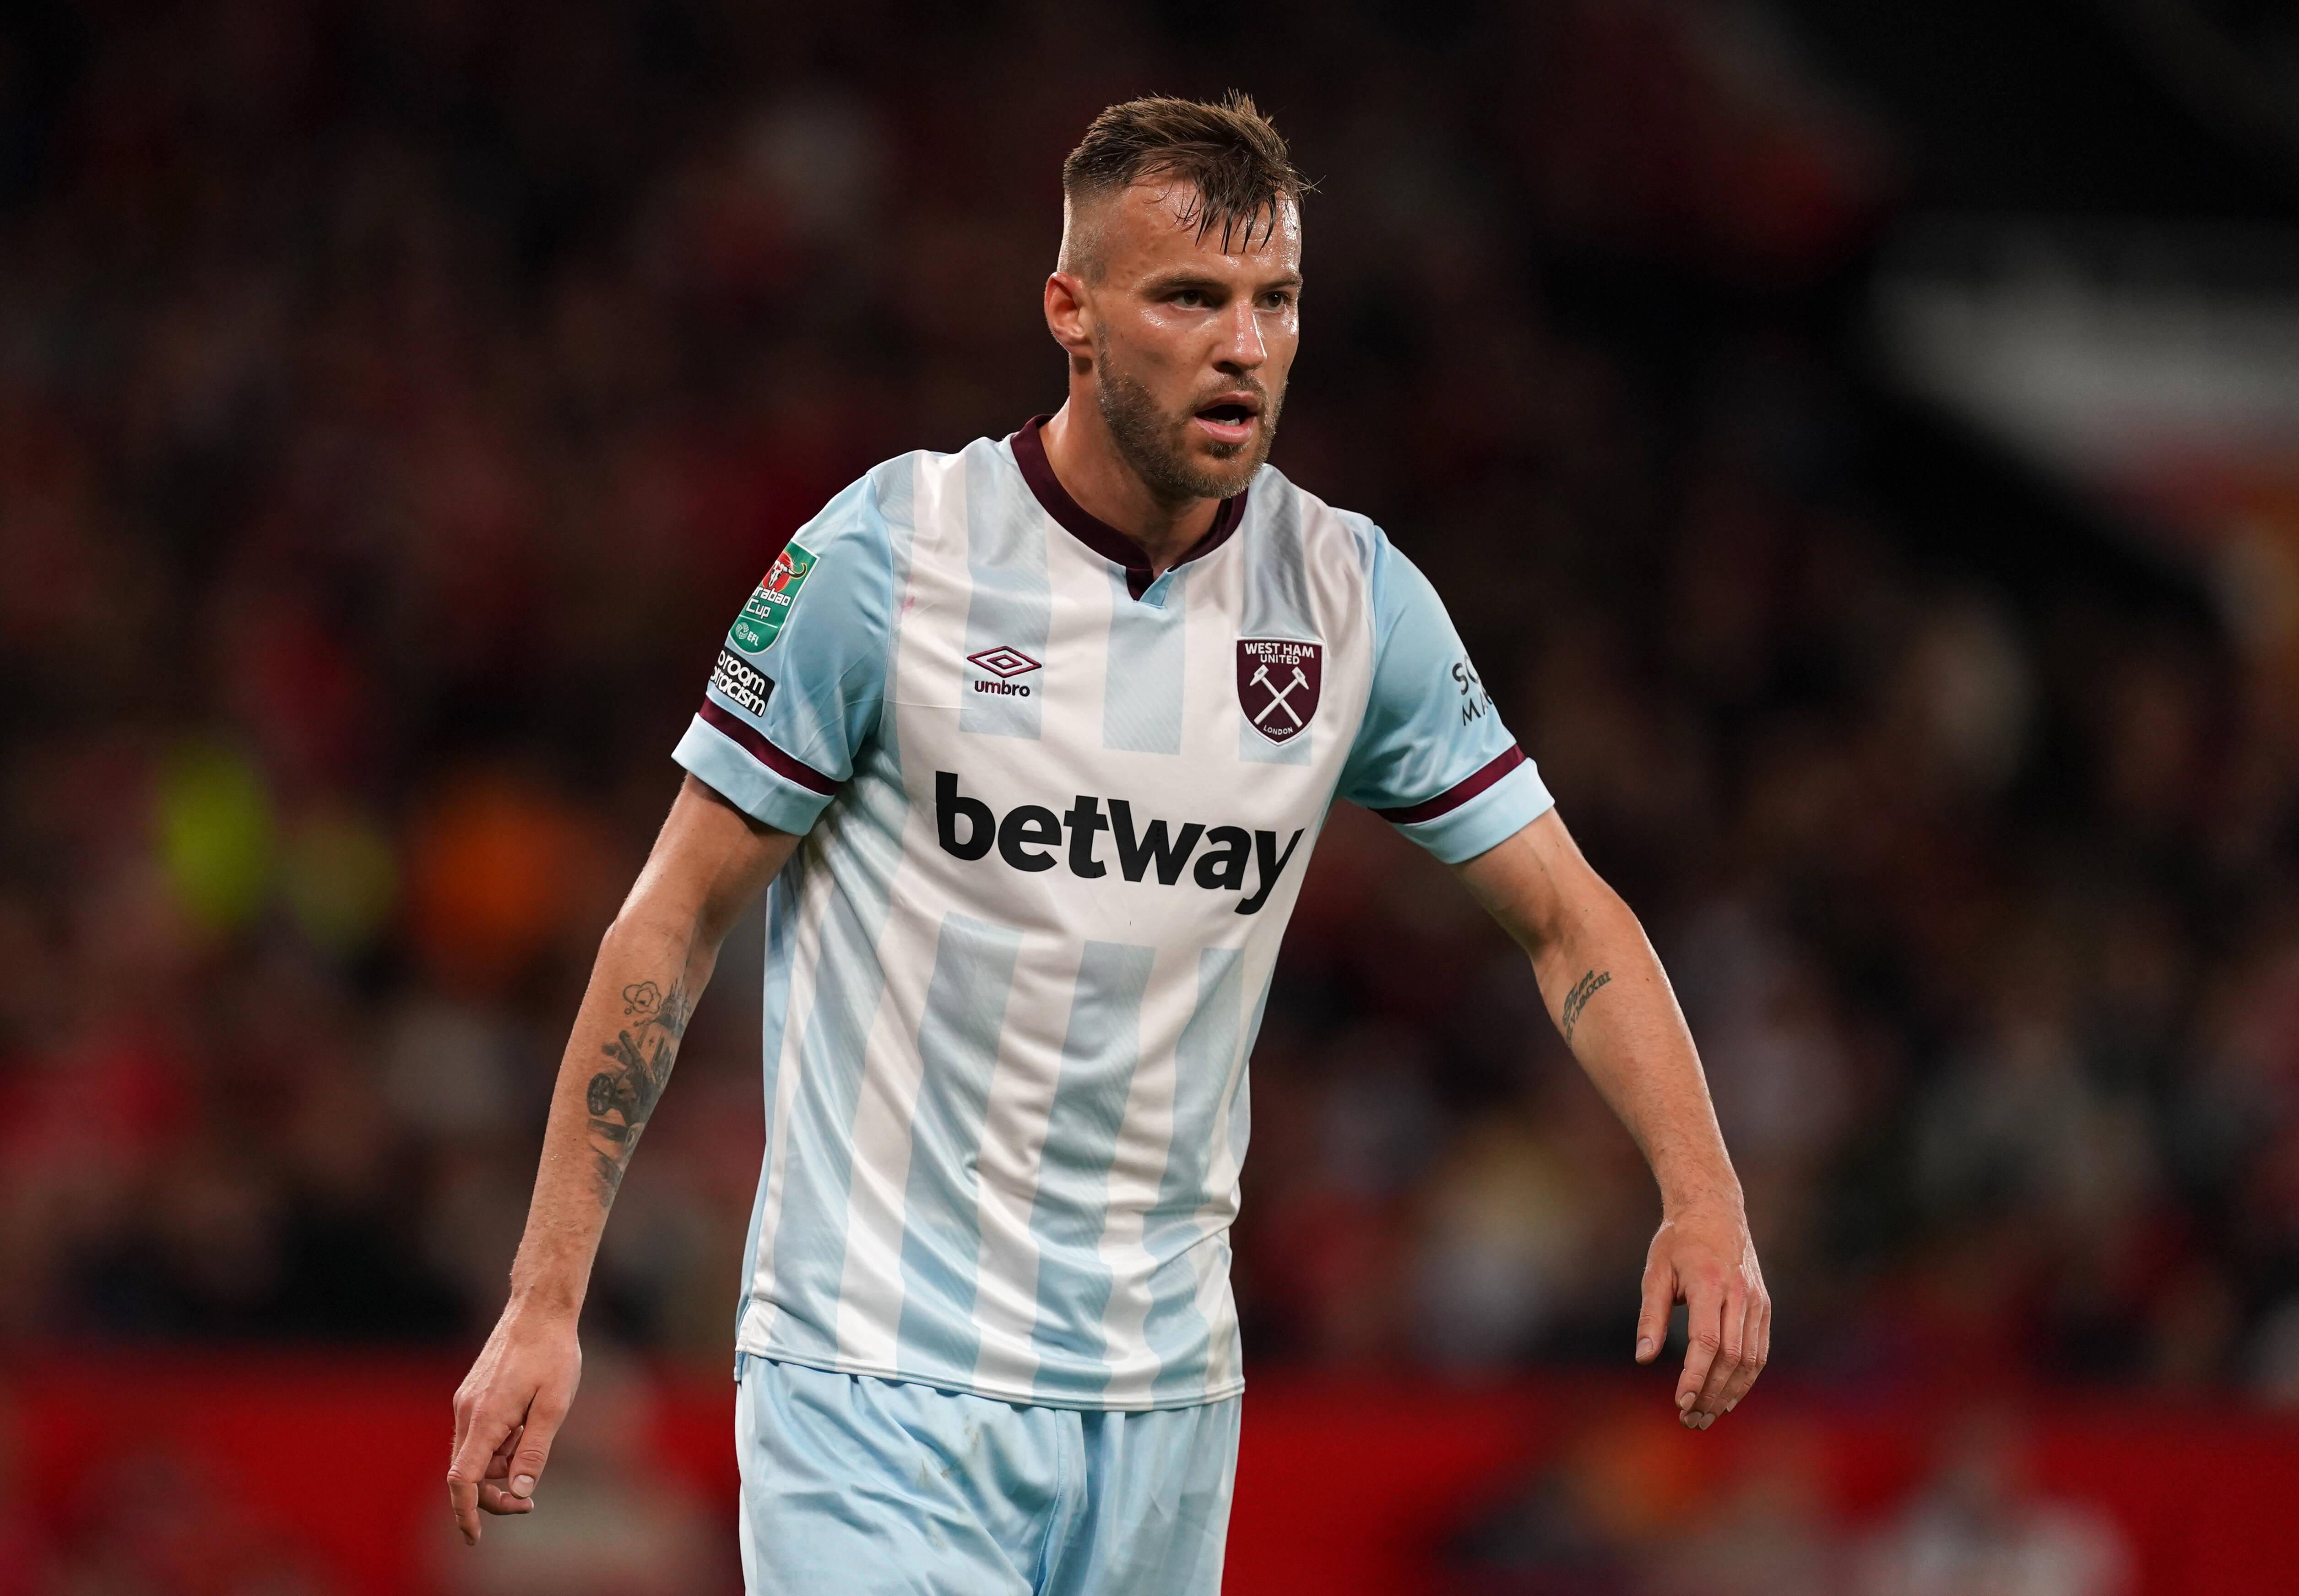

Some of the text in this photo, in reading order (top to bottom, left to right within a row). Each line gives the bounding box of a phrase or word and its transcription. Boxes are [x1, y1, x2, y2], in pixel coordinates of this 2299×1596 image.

[746, 598, 771, 619] Cup
[747, 631, 759, 646] EFL
[1245, 642, 1314, 658] WEST HAM
[1260, 654, 1300, 665] UNITED
[722, 655, 765, 695] room
[716, 673, 765, 717] racism
[974, 679, 1030, 697] umbro
[1263, 724, 1293, 735] LONDON
[935, 771, 1306, 915] betway
